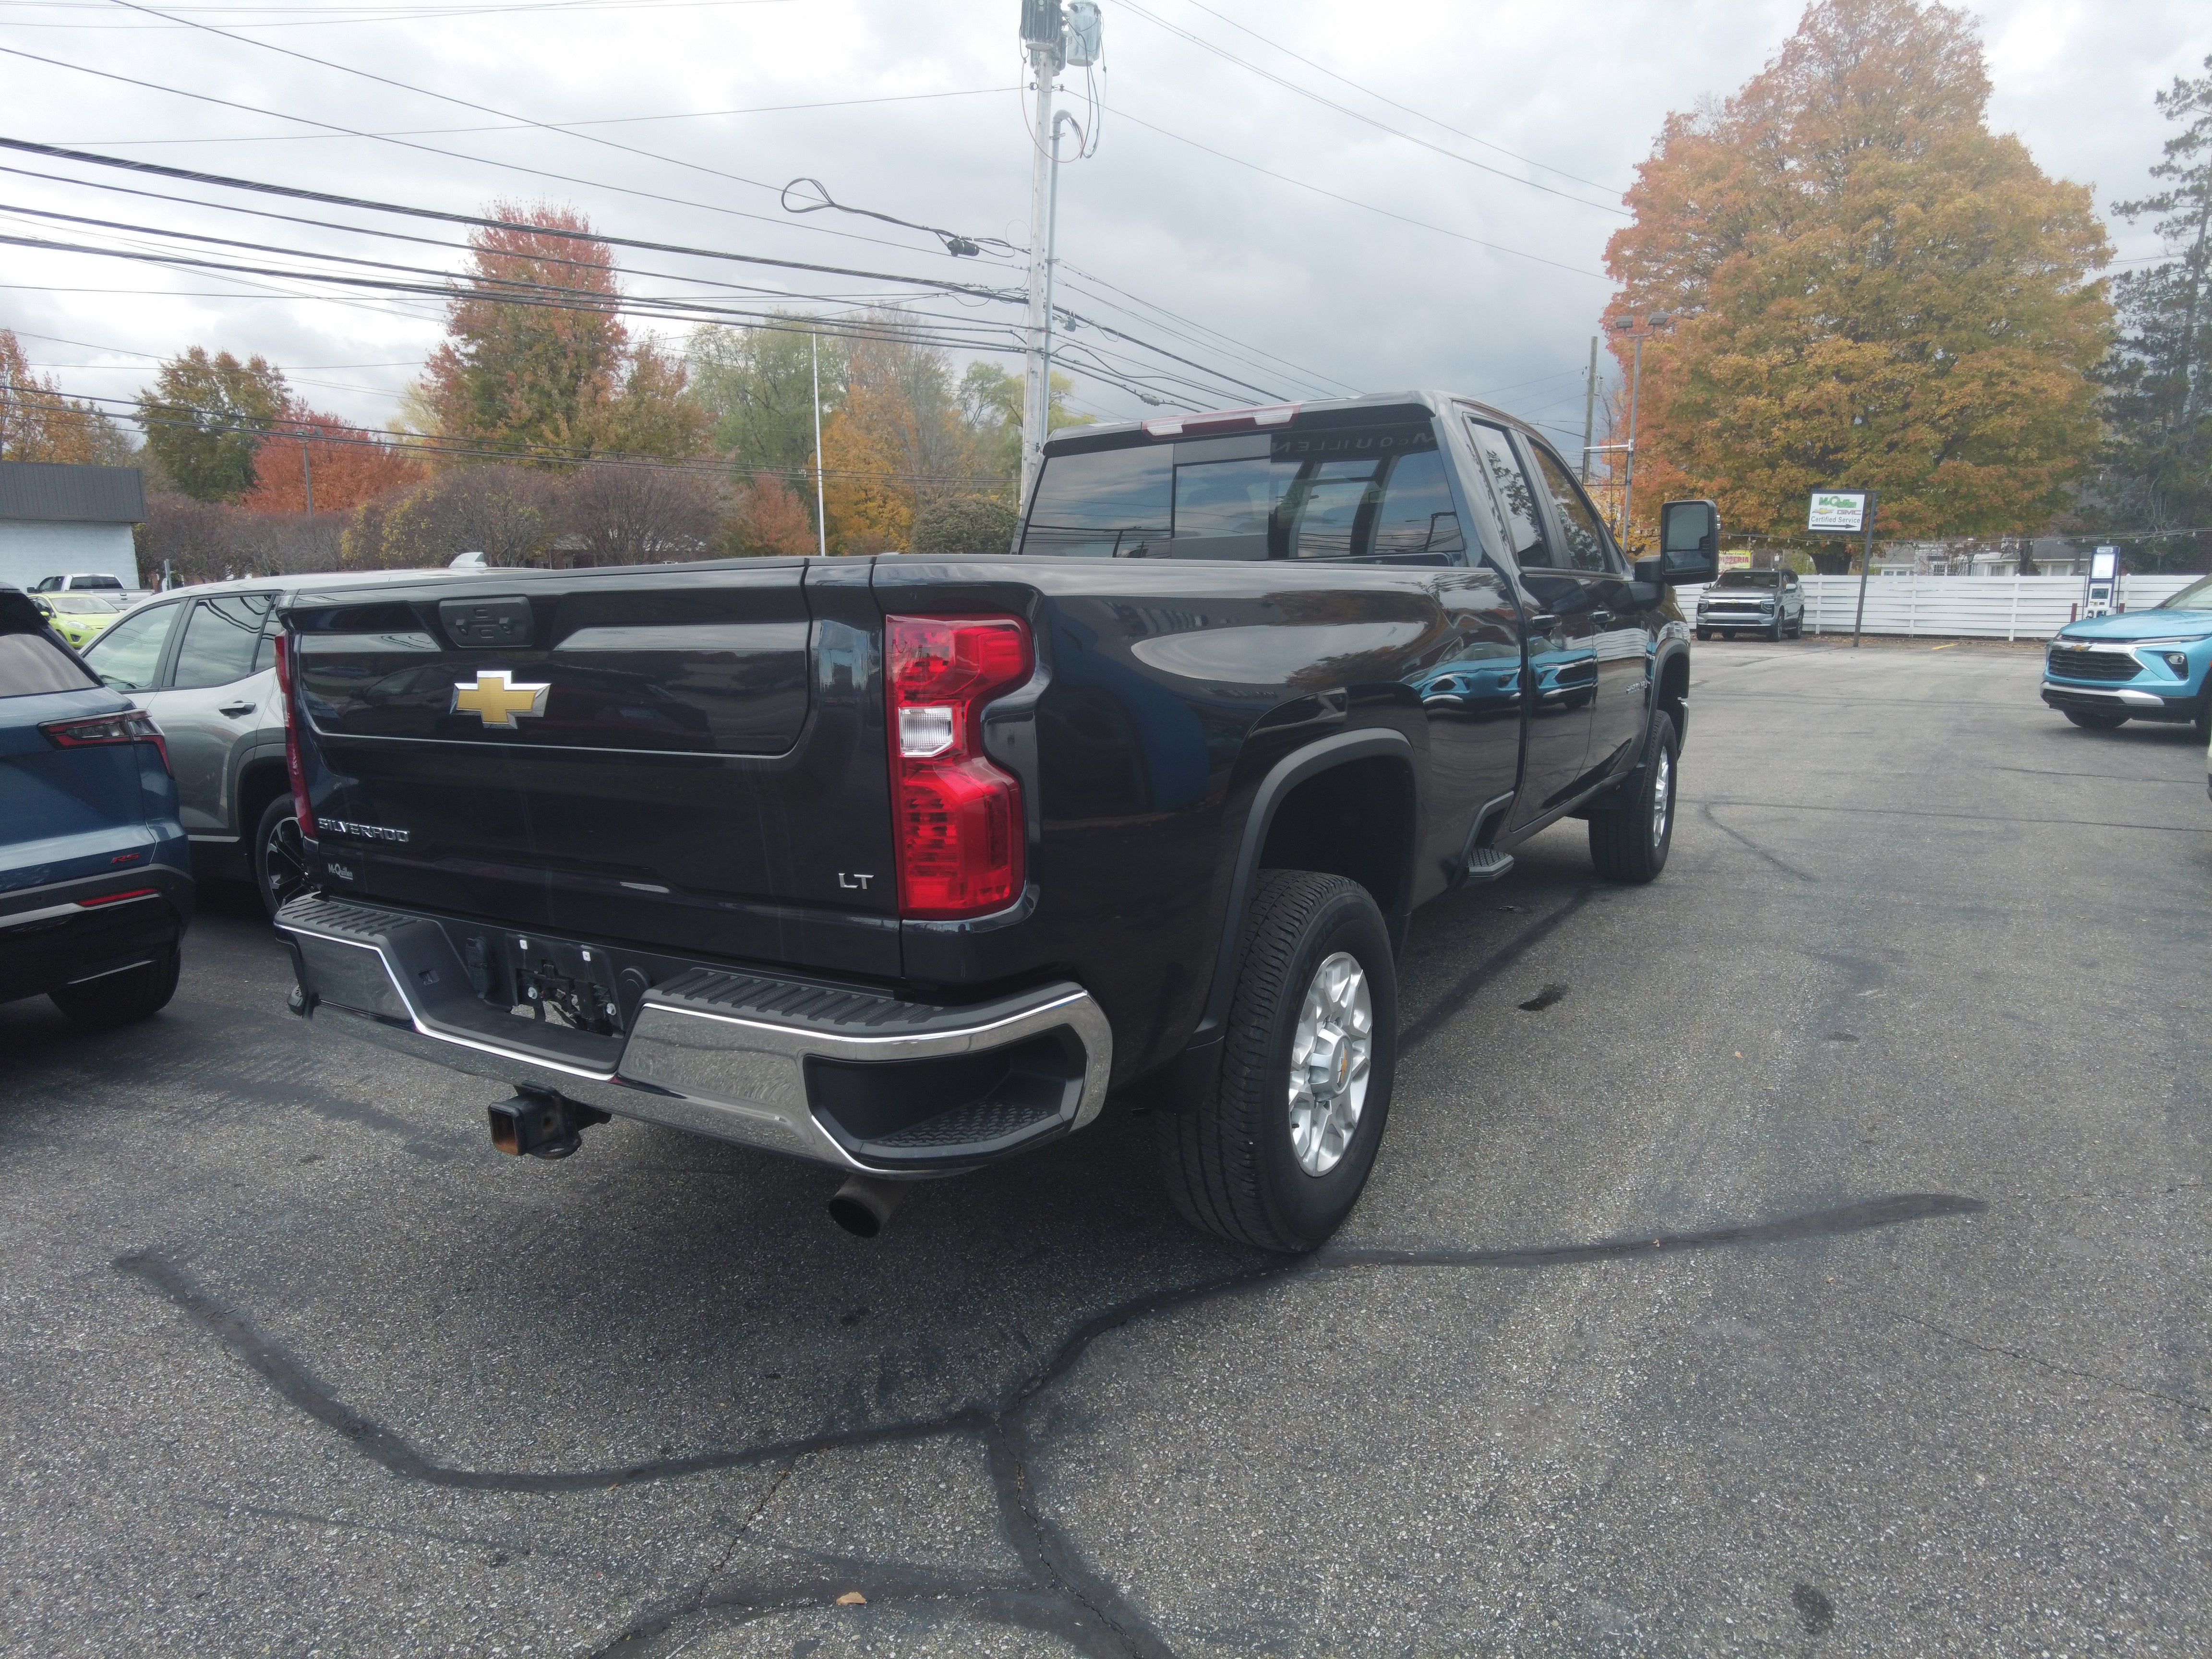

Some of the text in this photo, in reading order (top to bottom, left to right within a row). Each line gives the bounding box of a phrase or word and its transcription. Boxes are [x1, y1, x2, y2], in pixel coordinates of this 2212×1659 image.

[318, 817, 410, 842] SILVERADO
[110, 853, 139, 864] RS
[328, 863, 353, 880] McQuillen
[839, 873, 875, 889] LT
